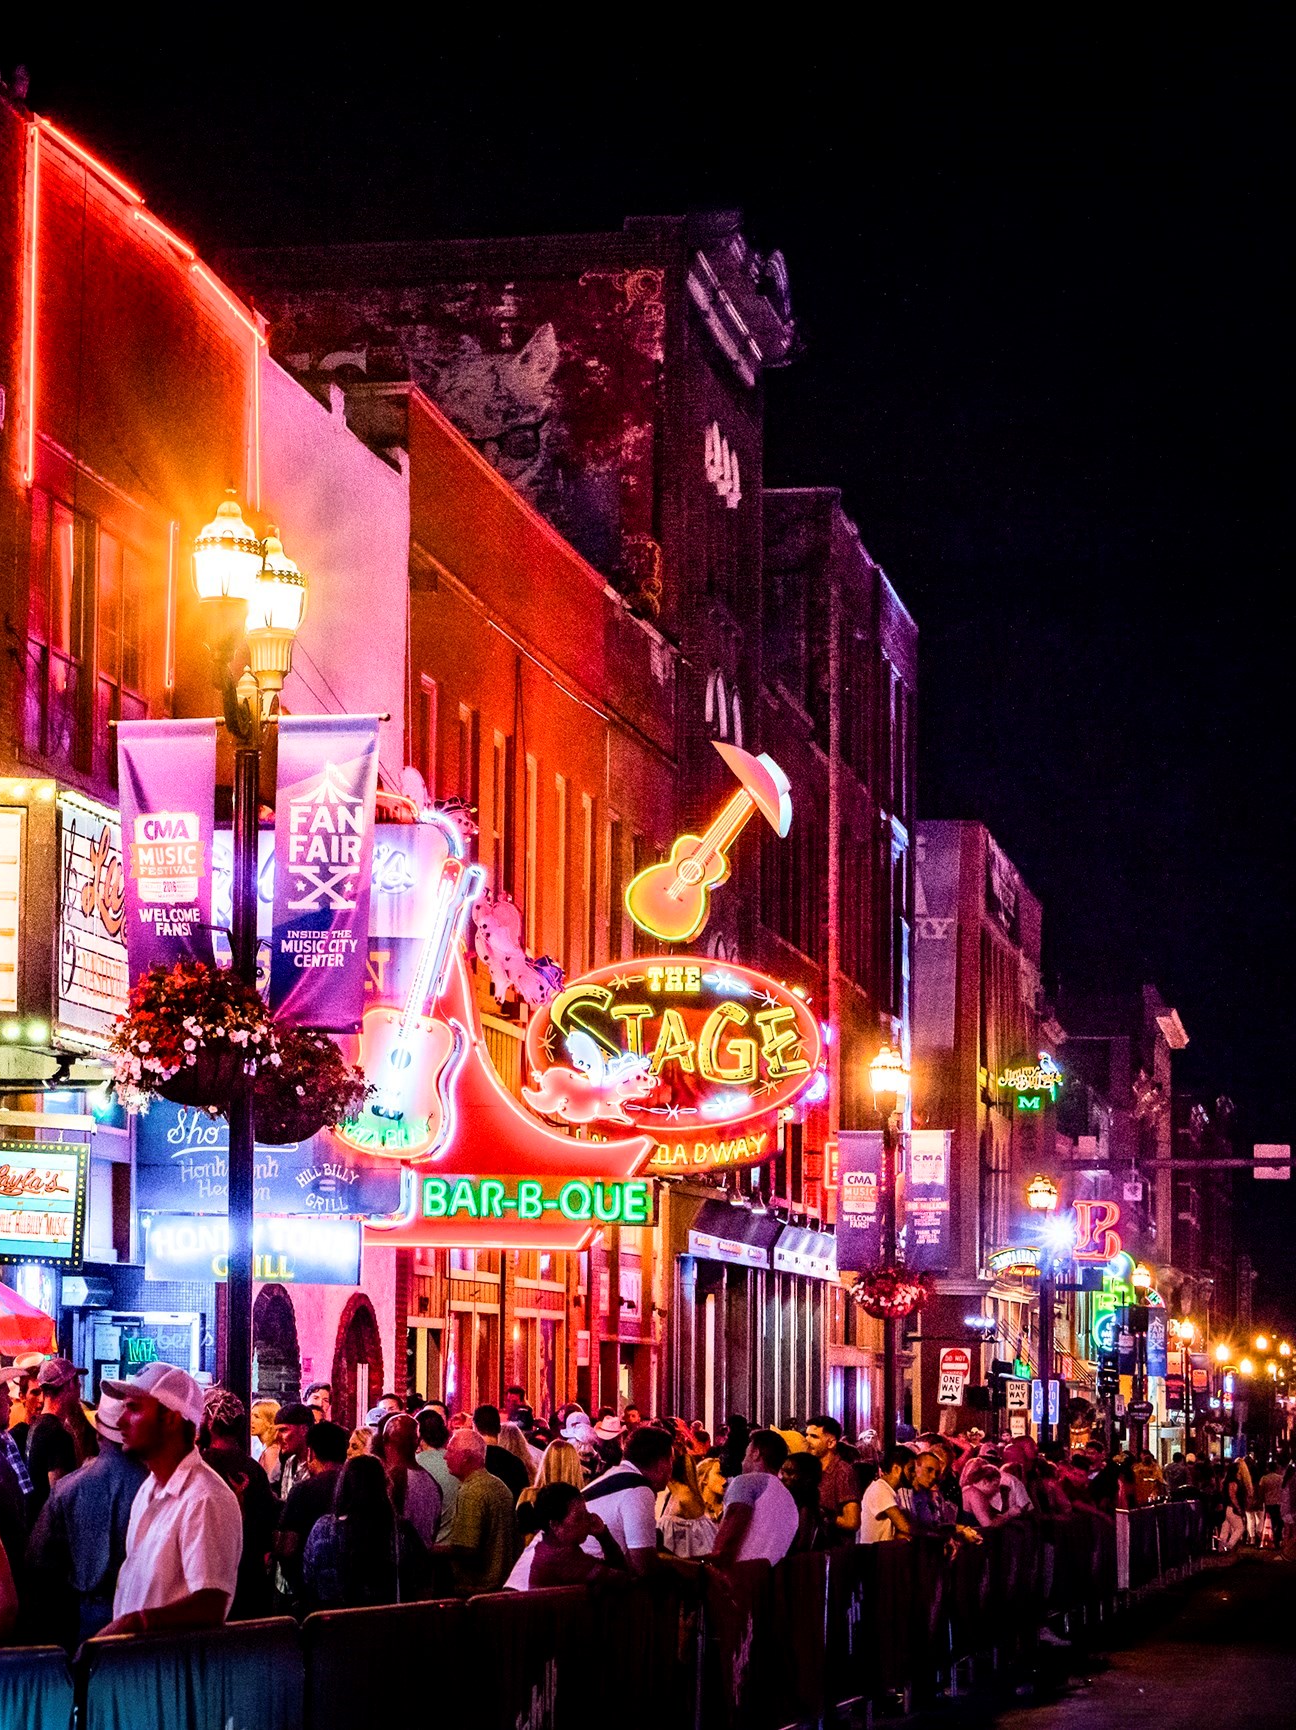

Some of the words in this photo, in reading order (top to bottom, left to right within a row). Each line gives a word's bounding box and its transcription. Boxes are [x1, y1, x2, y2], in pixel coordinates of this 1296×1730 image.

[289, 805, 364, 834] FAN
[143, 819, 190, 841] CMA
[137, 845, 197, 866] MUSIC
[288, 835, 362, 863] FAIR
[139, 866, 197, 876] FESTIVAL
[287, 864, 361, 910] X
[138, 907, 201, 923] WELCOME
[155, 922, 193, 937] FANS!
[287, 929, 330, 940] INSIDE
[331, 929, 352, 939] THE
[280, 939, 325, 954] MUSIC
[328, 938, 359, 953] CITY
[293, 953, 345, 968] CENTER
[647, 966, 702, 992] THE
[550, 983, 811, 1085] STAGE
[1017, 1095, 1041, 1109] M
[913, 1154, 943, 1162] CMA
[847, 1175, 872, 1185] CMA
[843, 1187, 876, 1196] MUSIC
[305, 1192, 349, 1212] GRILL
[422, 1177, 648, 1222] BAR-B-QUE
[45, 1215, 68, 1237] MUSIC
[842, 1215, 877, 1223] WELCOME
[943, 1375, 960, 1385] ONE
[1009, 1383, 1025, 1391] ONE
[941, 1384, 961, 1393] WAY
[1008, 1391, 1026, 1399] WAY
